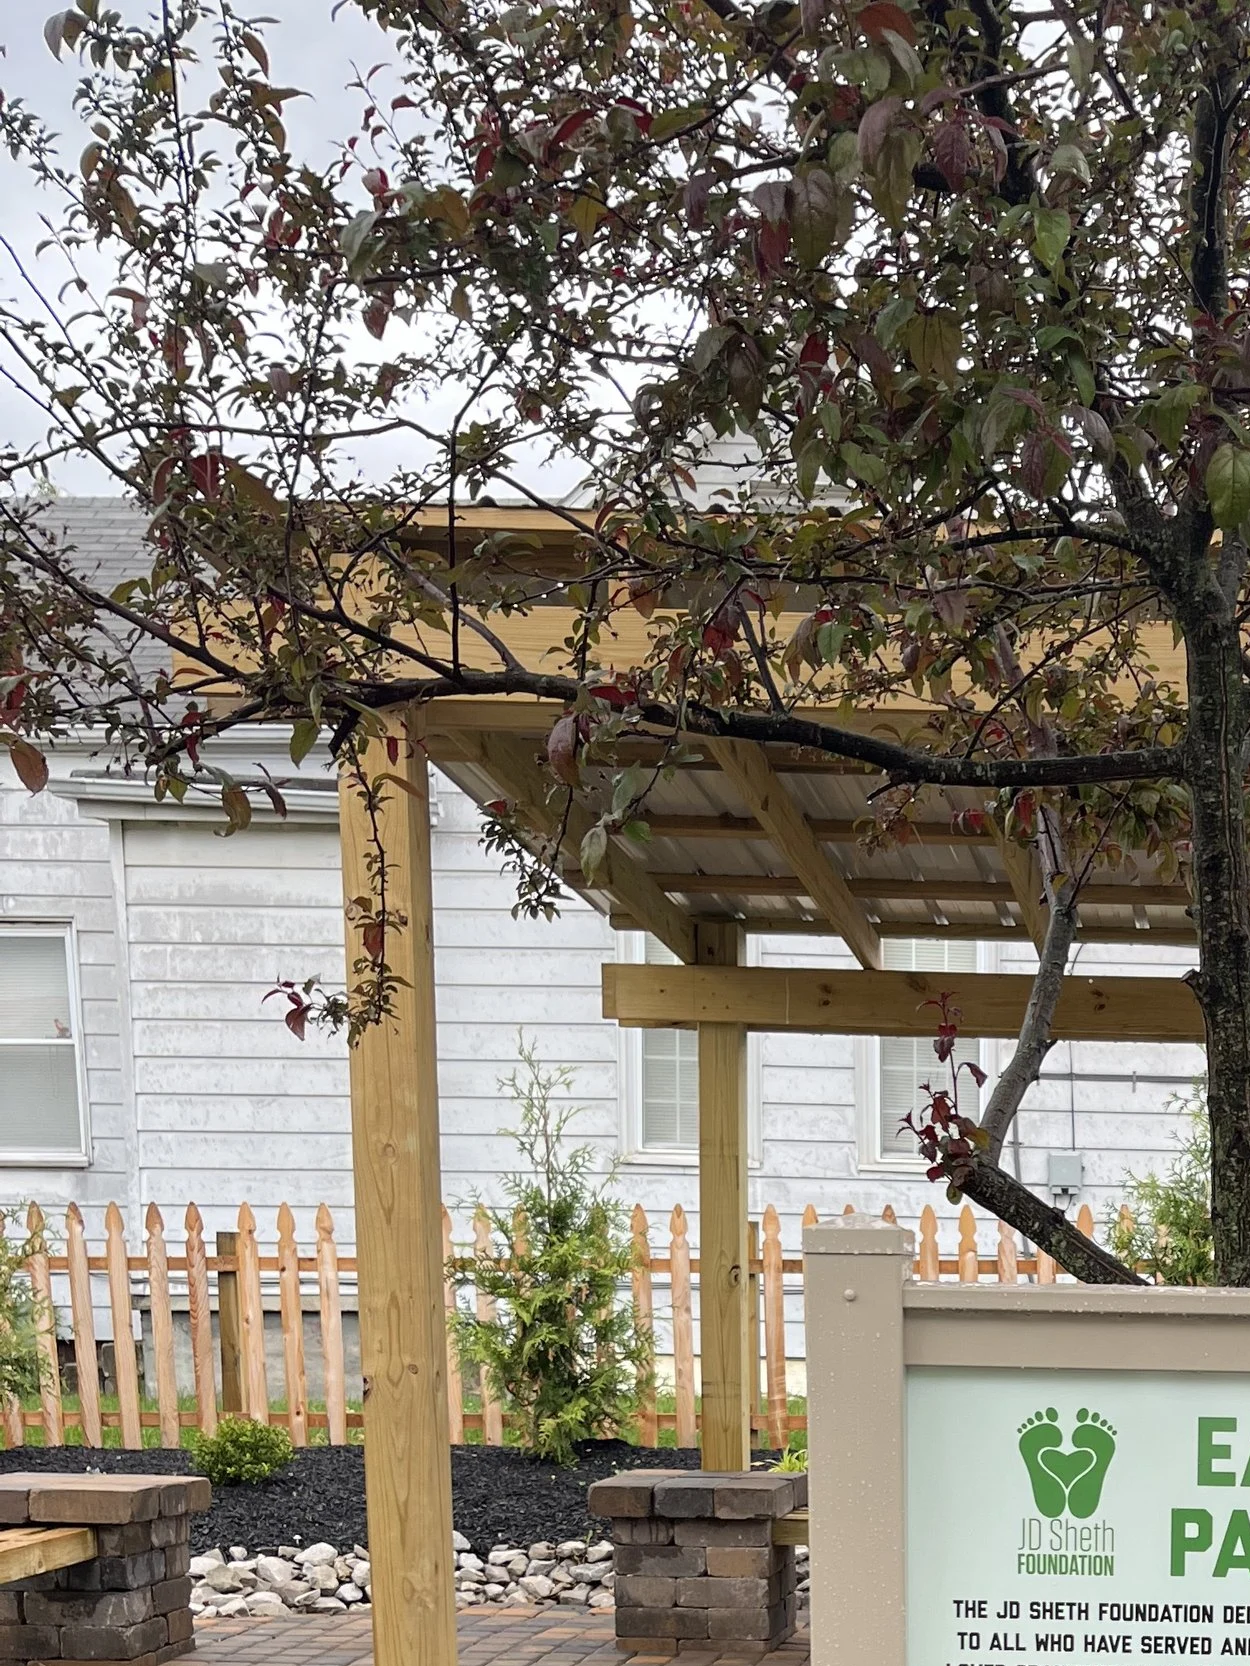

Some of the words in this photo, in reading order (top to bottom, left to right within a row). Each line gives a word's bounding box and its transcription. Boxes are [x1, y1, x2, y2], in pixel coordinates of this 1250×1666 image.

[1017, 1517, 1042, 1552] JD
[1049, 1518, 1116, 1553] Sheth
[1017, 1553, 1115, 1577] FOUNDATION
[952, 1599, 988, 1619] THE
[996, 1600, 1021, 1620] JD
[1029, 1601, 1090, 1621] SHETH
[1098, 1602, 1214, 1624] FOUNDATION
[956, 1631, 981, 1651] TO
[988, 1632, 1027, 1652] ALL
[1034, 1632, 1075, 1653] WHO
[1083, 1633, 1133, 1654] HAVE
[1140, 1635, 1213, 1656] SERVED
